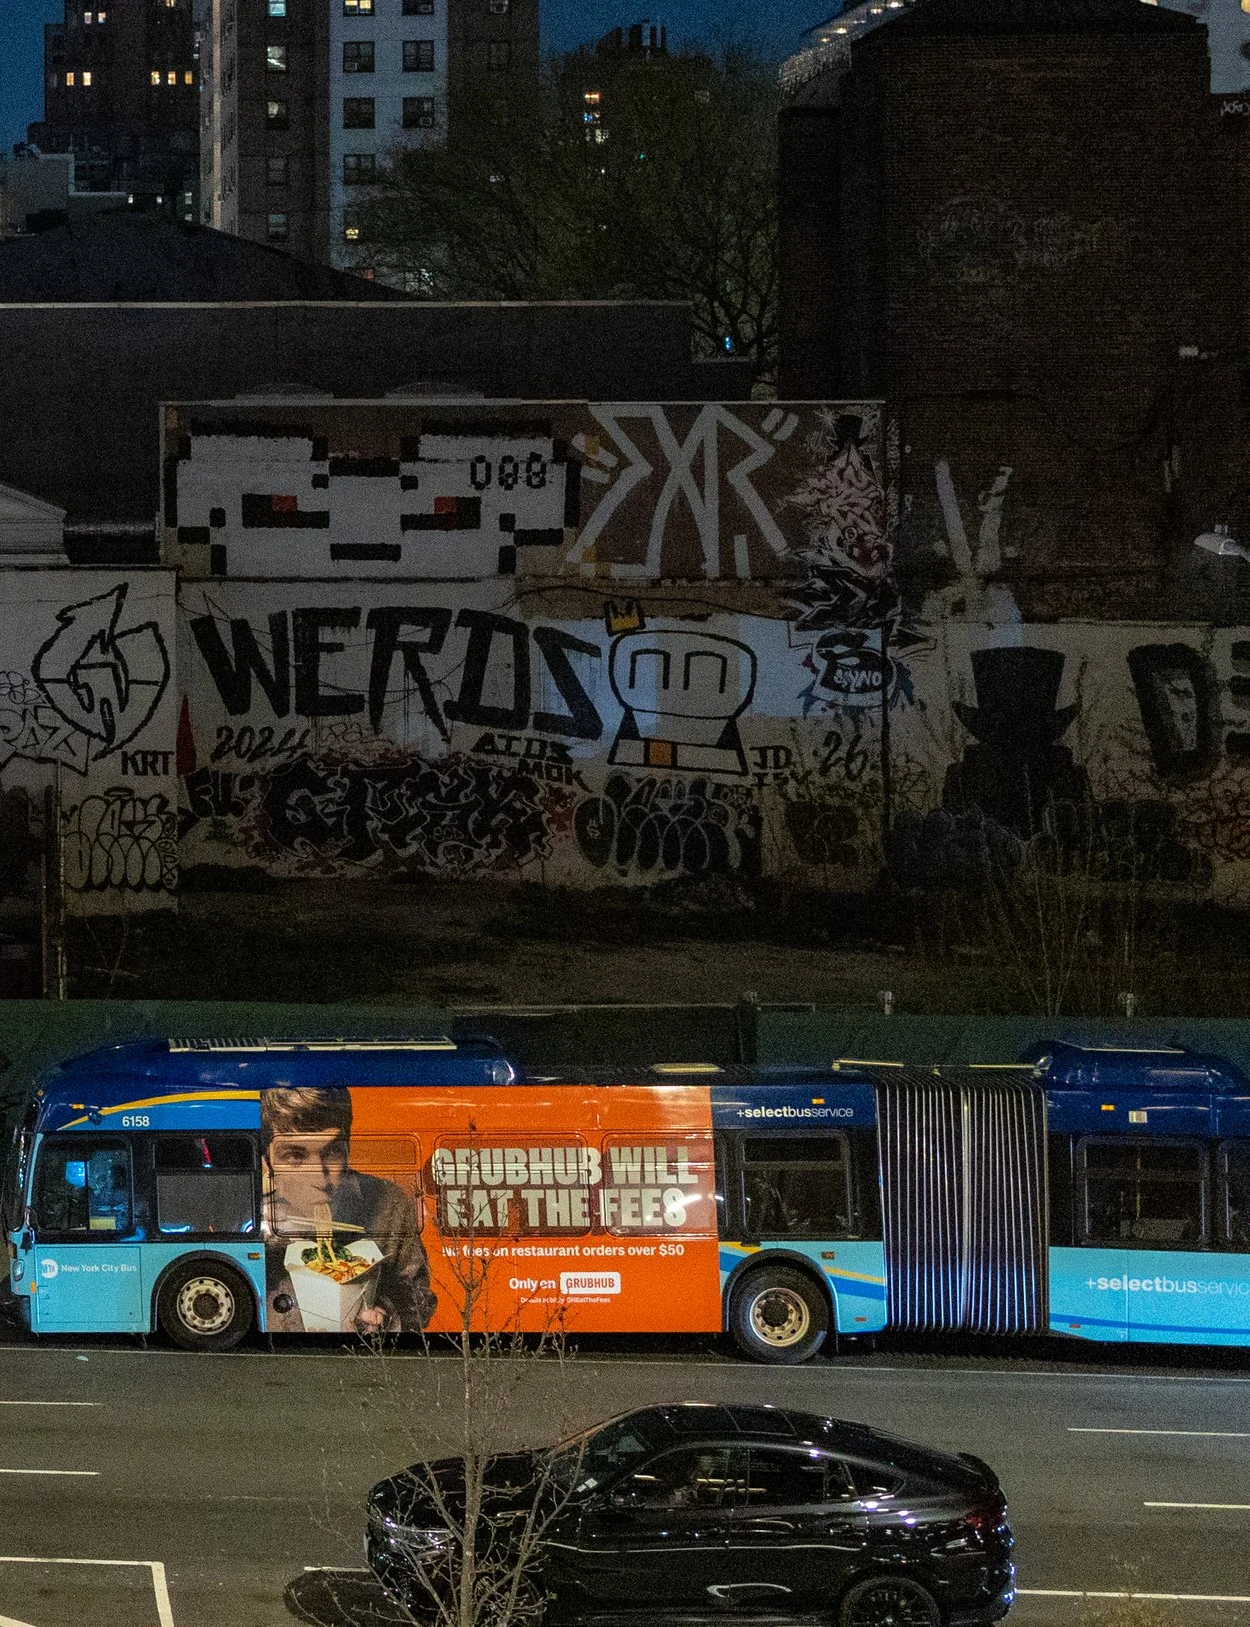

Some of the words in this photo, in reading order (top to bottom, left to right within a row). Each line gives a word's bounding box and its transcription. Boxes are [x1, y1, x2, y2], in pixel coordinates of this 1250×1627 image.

[210, 724, 311, 763] 2024
[121, 750, 174, 776] KRT
[122, 1115, 150, 1128] 6158
[432, 1147, 602, 1186] GRUBHUB
[610, 1146, 699, 1185] WILL
[447, 1189, 514, 1228] EAT
[520, 1188, 591, 1227] THE
[599, 1187, 687, 1227] FEES
[511, 1245, 580, 1257] restaurant
[583, 1245, 625, 1257] orders
[627, 1247, 657, 1257] over
[659, 1244, 685, 1257] $50
[61, 1264, 80, 1272] New
[81, 1263, 100, 1273] York
[101, 1263, 119, 1275] City
[120, 1263, 138, 1272] Bus
[508, 1277, 539, 1292] Only
[539, 1280, 556, 1289] on
[565, 1277, 615, 1289] GRUBHUB
